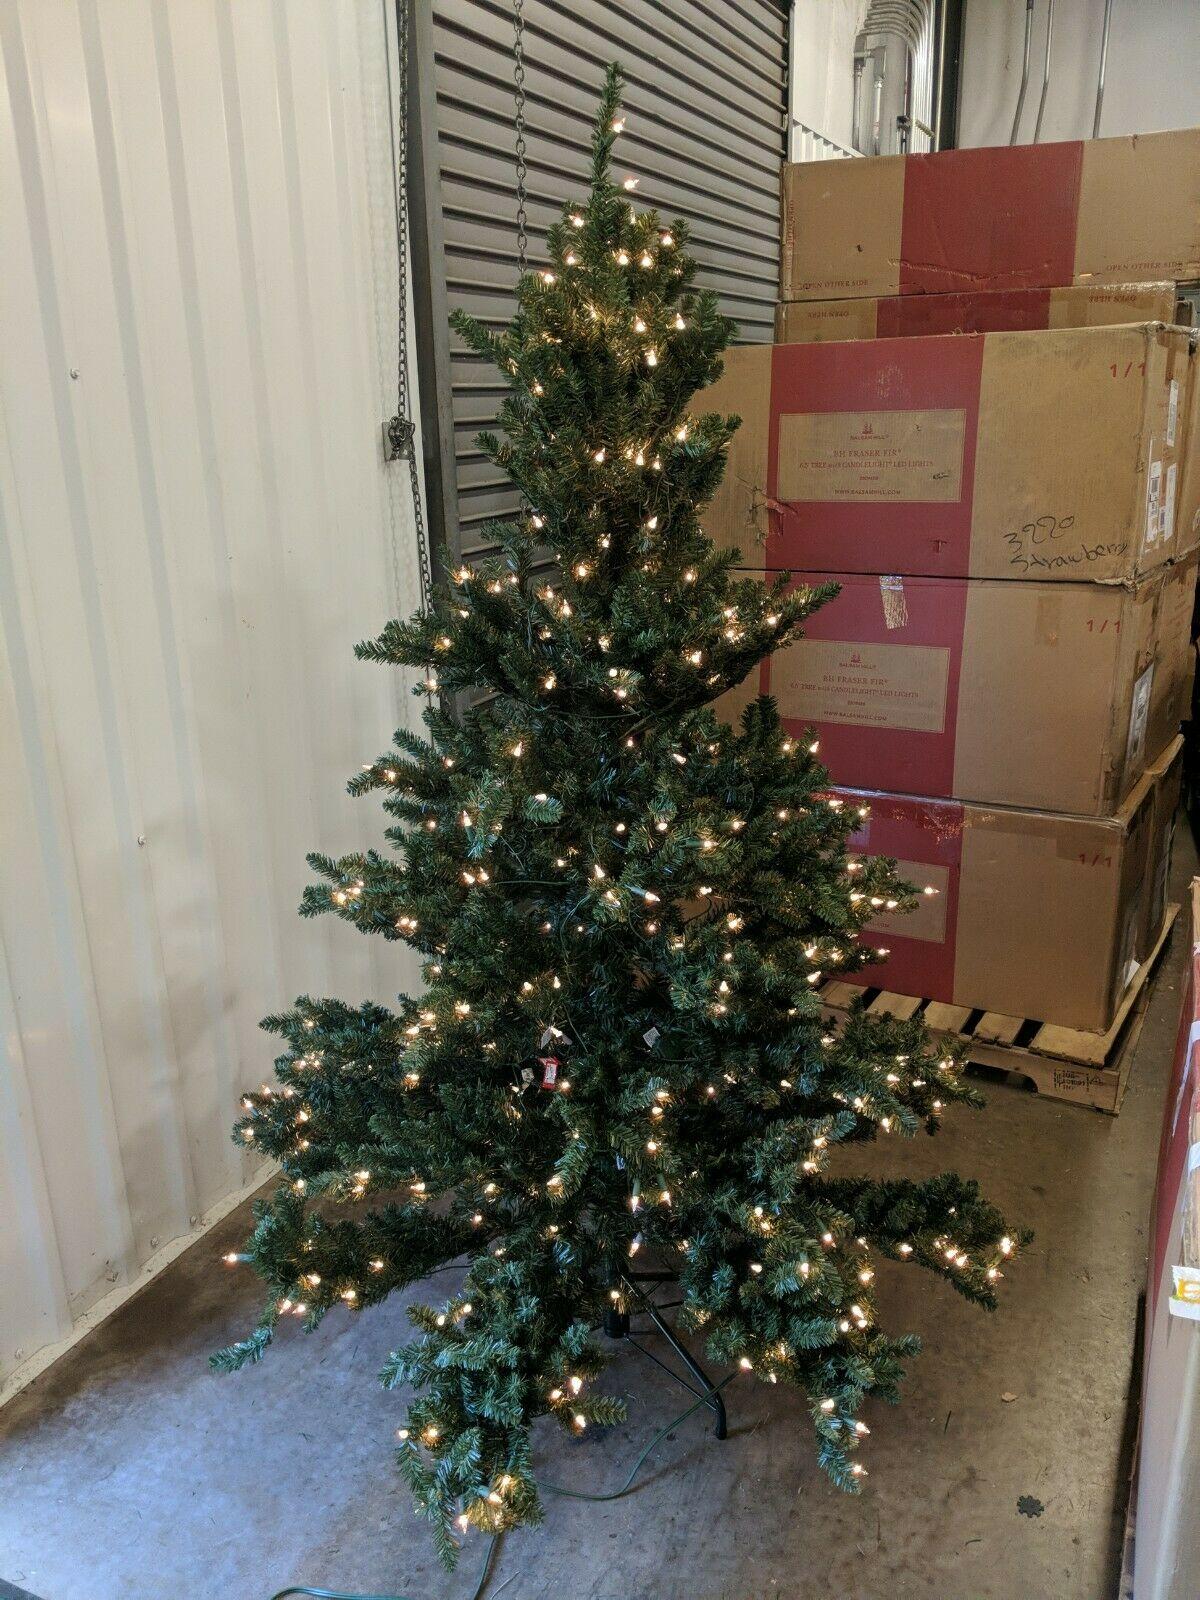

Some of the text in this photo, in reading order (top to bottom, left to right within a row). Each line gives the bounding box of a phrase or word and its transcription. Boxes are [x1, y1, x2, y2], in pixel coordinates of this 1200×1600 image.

[1106, 263, 1130, 272] OPEN
[1131, 262, 1160, 270] OTHER
[848, 449, 880, 458] FRASER
[837, 675, 868, 685] FRASER
